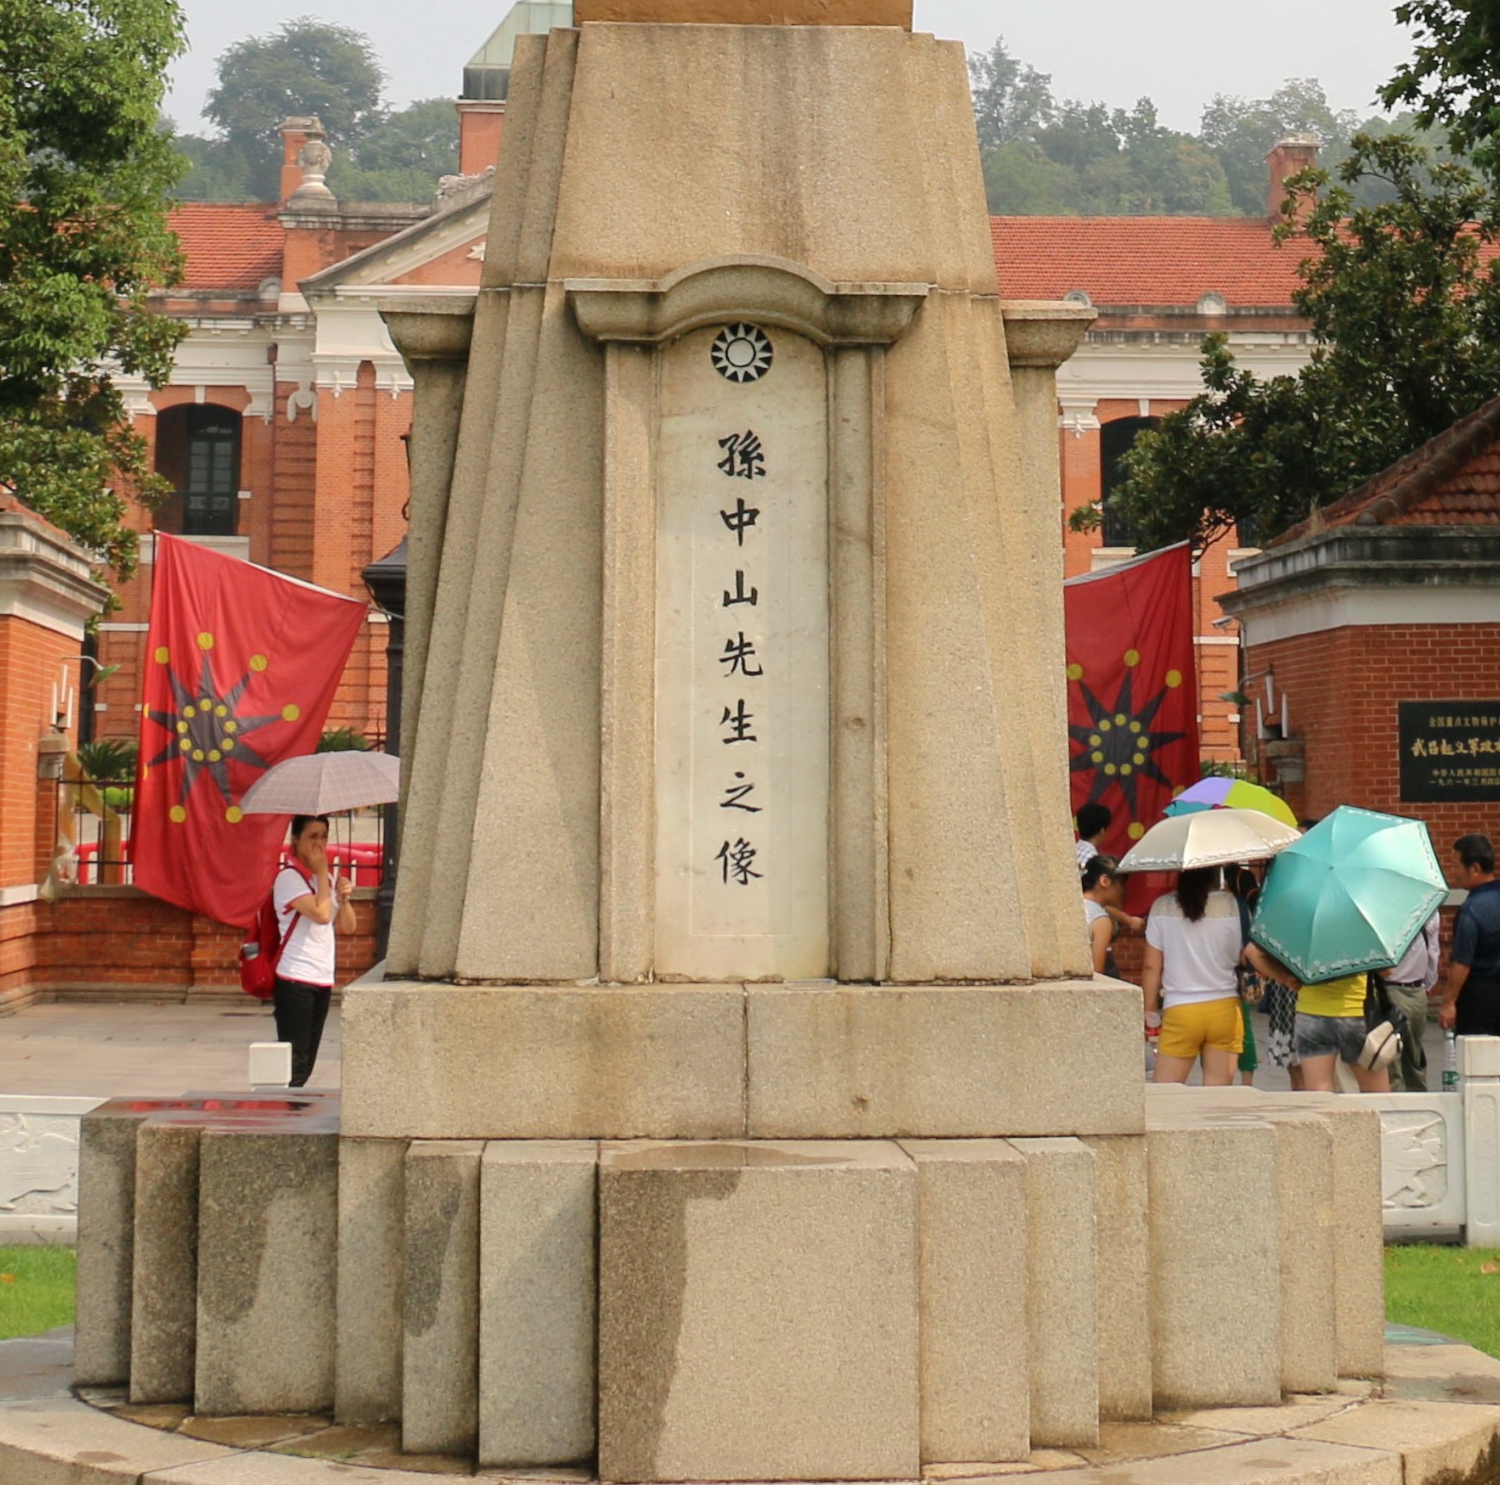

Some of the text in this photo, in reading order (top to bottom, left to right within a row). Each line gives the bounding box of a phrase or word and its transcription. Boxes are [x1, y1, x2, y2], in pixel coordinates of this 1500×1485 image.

[714, 428, 767, 886] 孫中山先生之像
